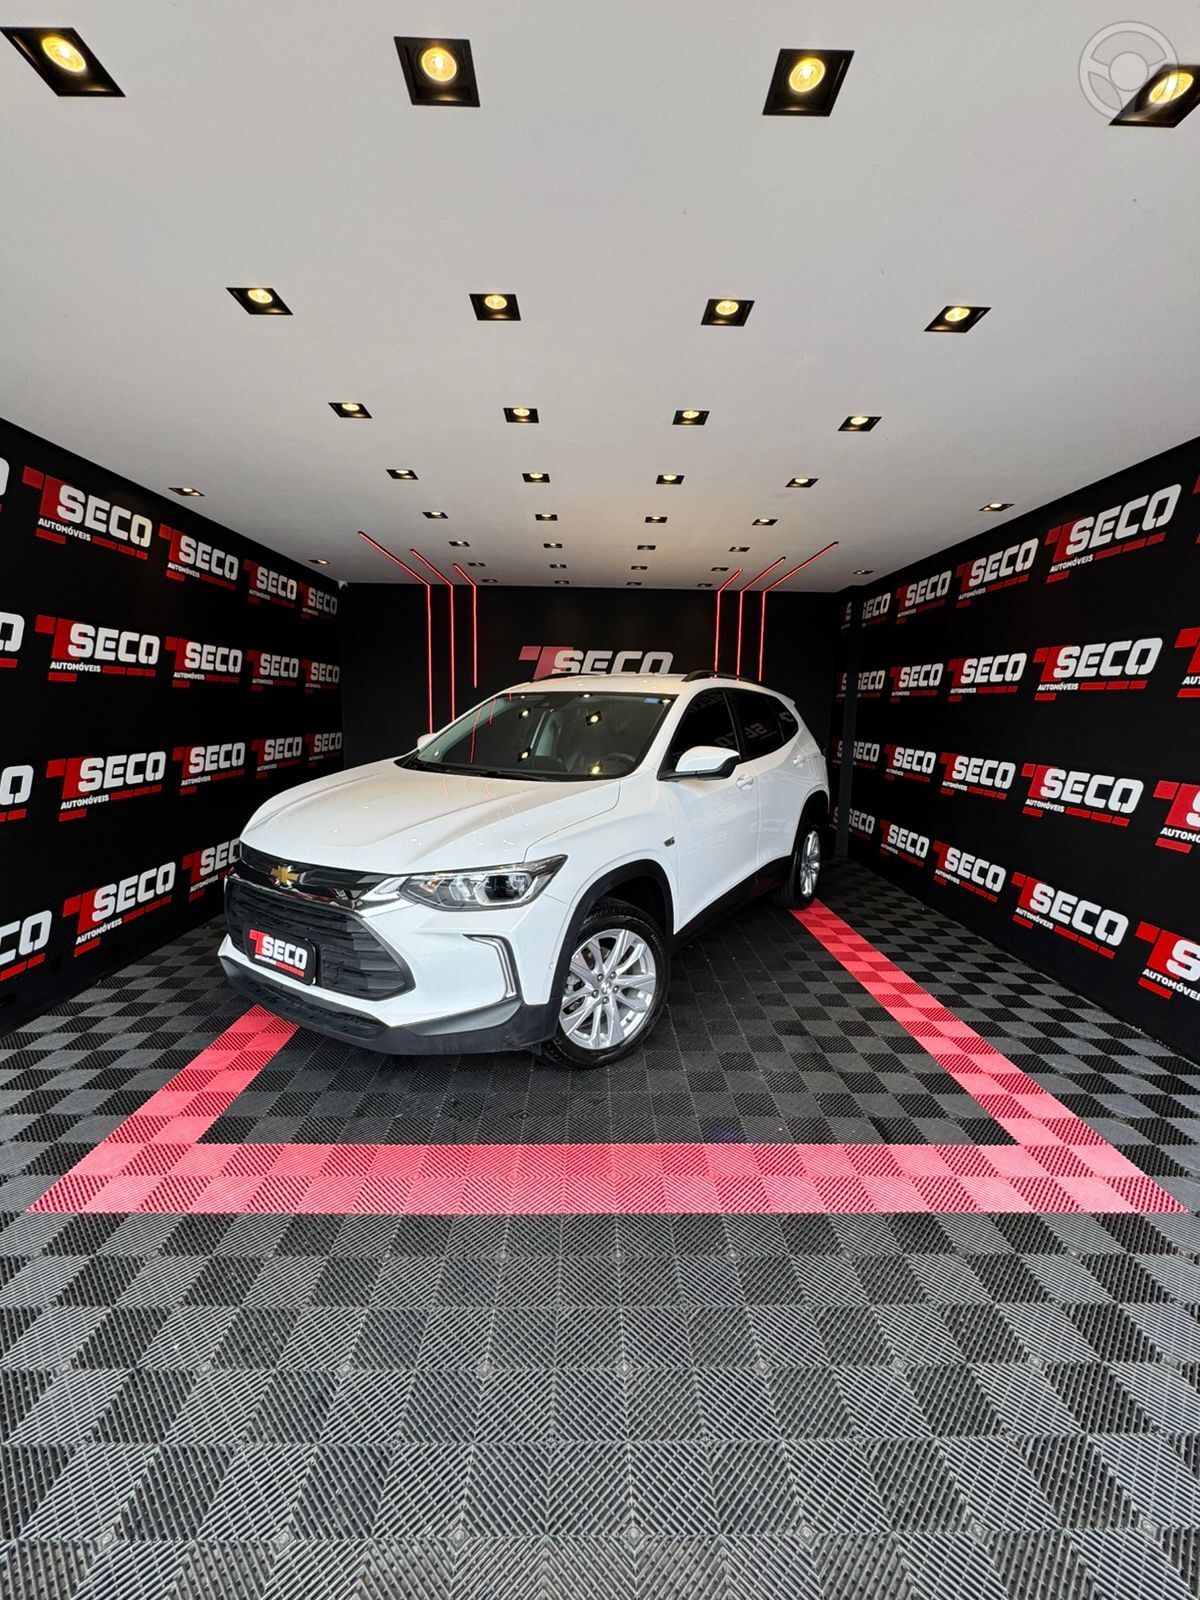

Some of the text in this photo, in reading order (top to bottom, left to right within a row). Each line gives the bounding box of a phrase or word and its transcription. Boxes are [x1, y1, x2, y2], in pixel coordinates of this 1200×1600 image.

[38, 518, 91, 541] AUTOMÓVEIS
[50, 661, 101, 673] AUTOMÓVEIS
[60, 794, 109, 810] AUTOMÓVEIS
[75, 918, 122, 945] AUTOMÓVEIS
